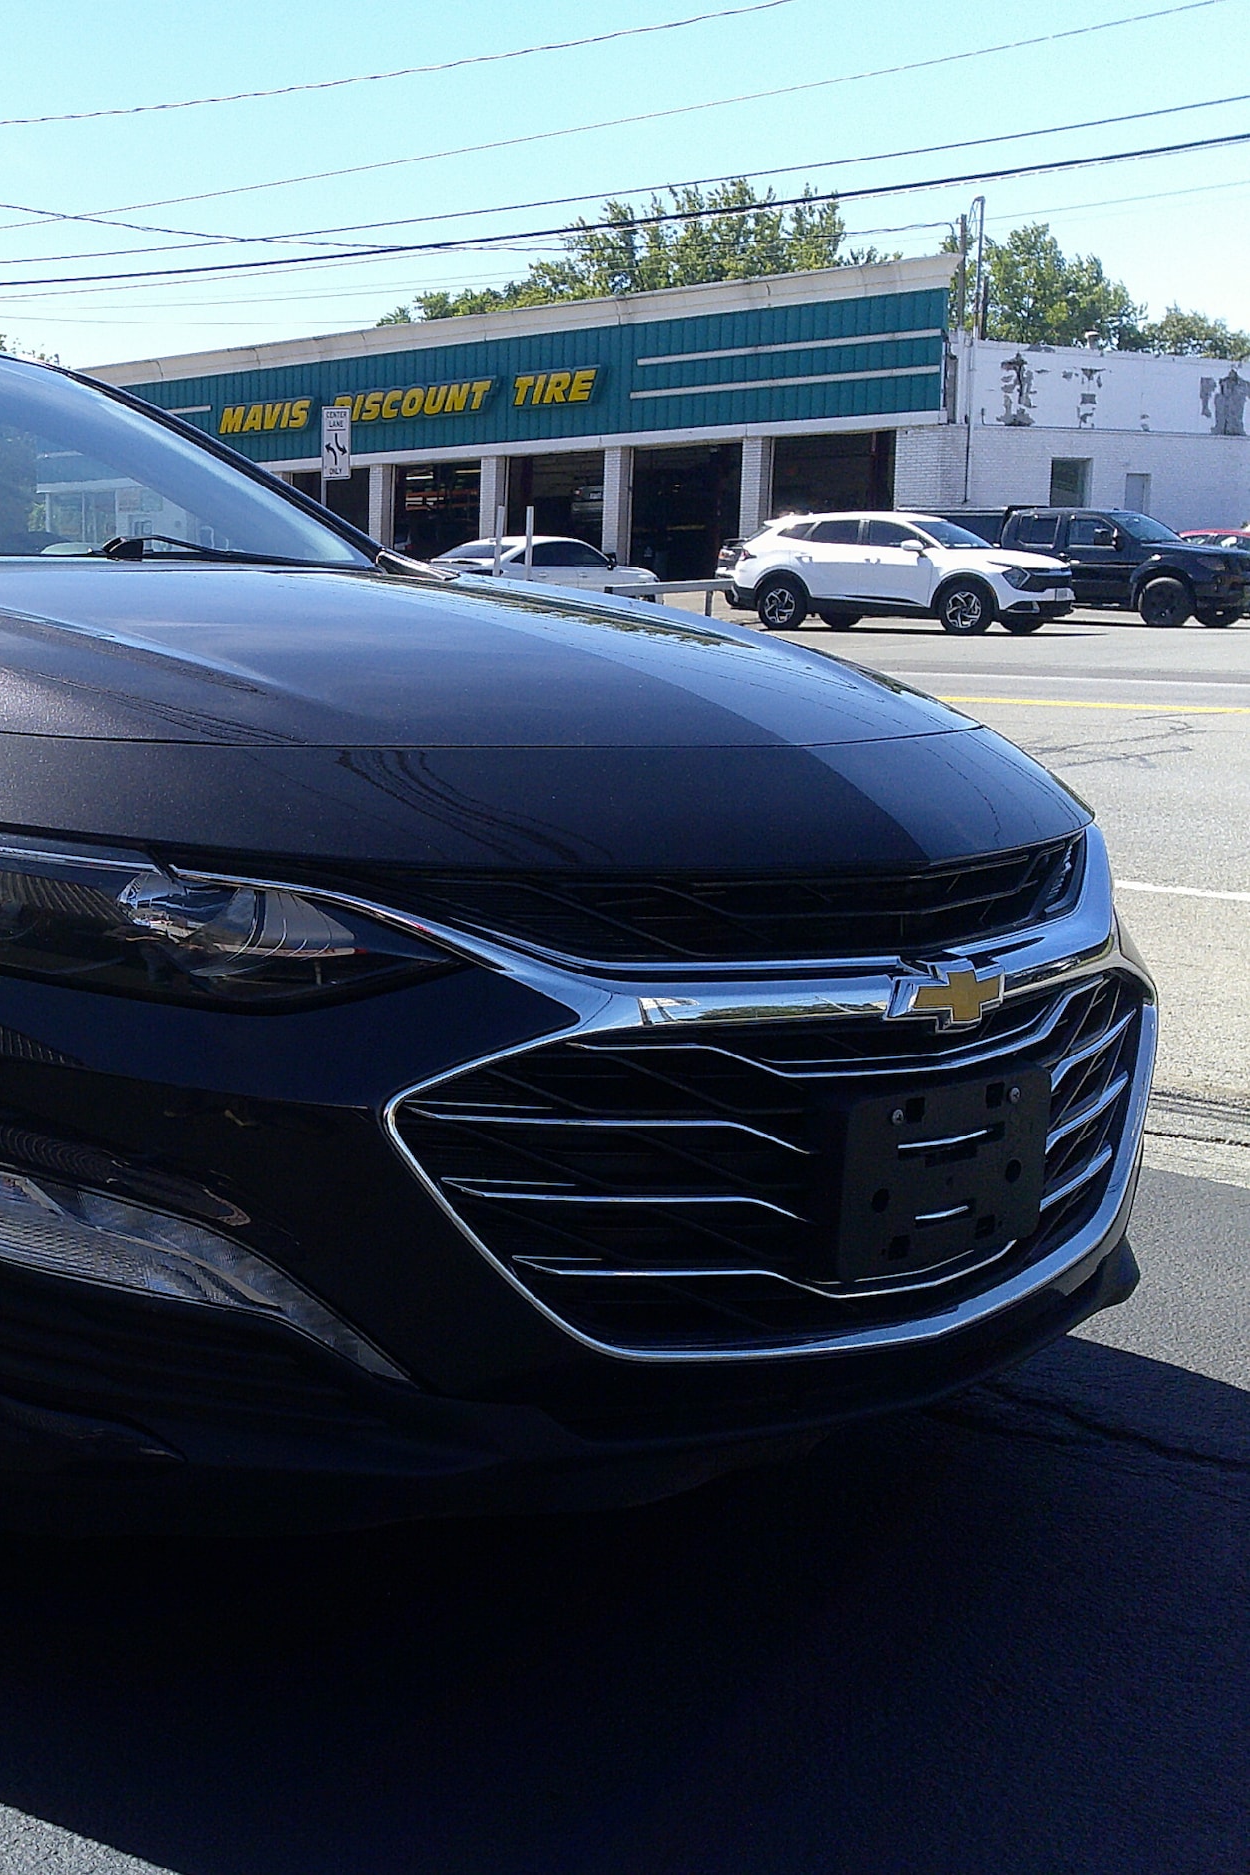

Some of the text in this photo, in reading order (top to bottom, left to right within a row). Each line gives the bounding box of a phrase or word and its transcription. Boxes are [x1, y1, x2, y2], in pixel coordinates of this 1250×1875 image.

[219, 400, 312, 434] MAVIS
[514, 369, 598, 406] TIRE
[329, 420, 344, 428] LANE
[329, 467, 342, 475] ONLY
